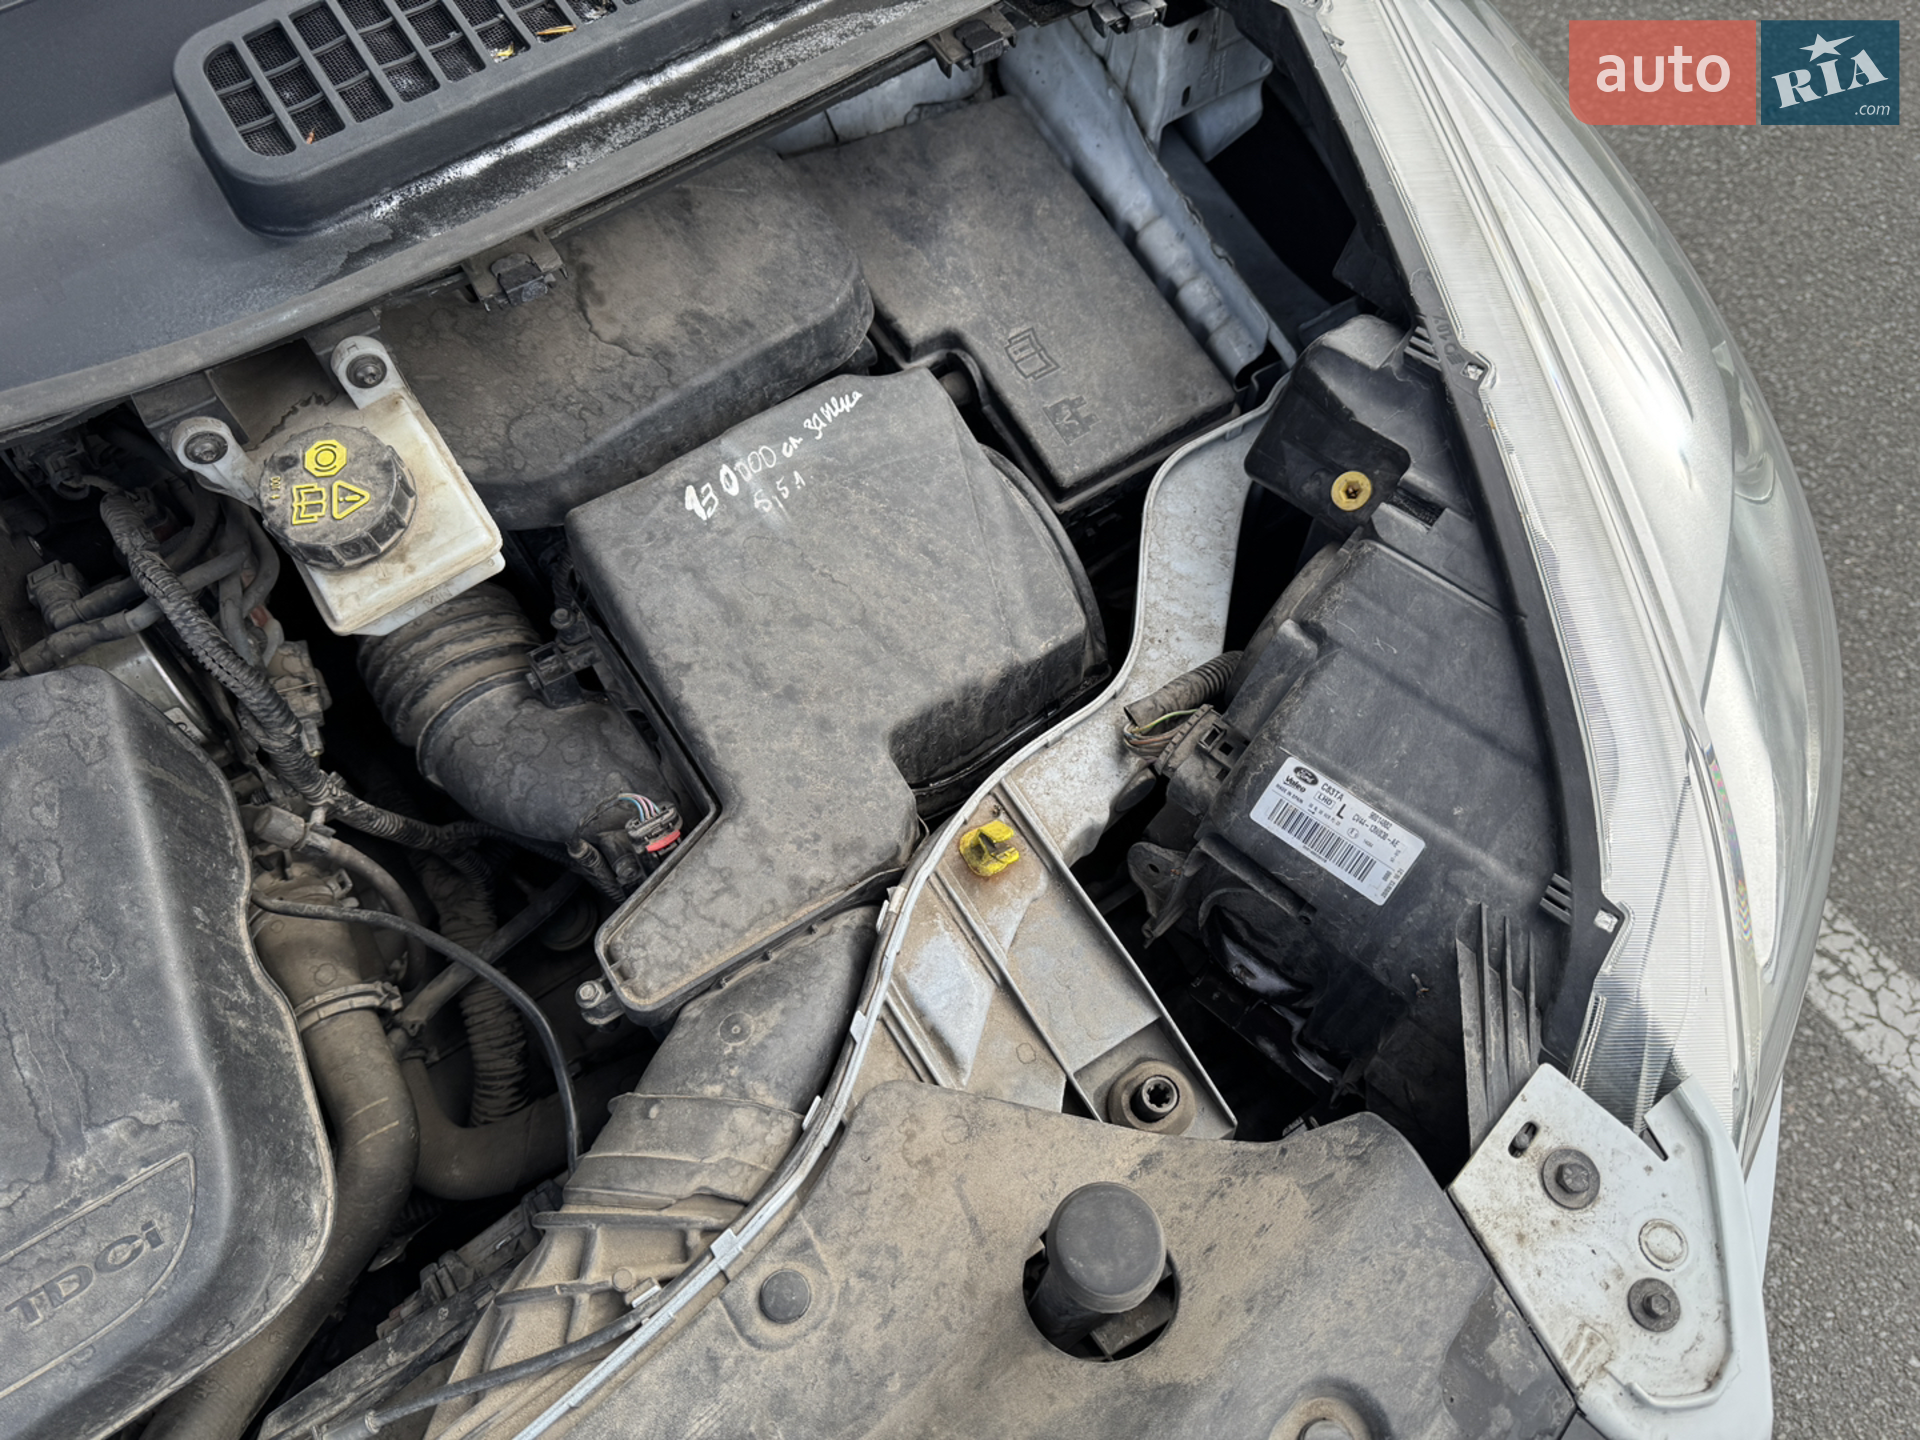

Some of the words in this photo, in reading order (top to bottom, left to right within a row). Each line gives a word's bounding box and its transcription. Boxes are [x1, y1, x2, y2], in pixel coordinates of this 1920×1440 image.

[1285, 775, 1306, 793] Valeo
[1294, 768, 1317, 784] Ford
[1317, 794, 1333, 806] LHD
[1336, 804, 1346, 819] L
[4, 1219, 165, 1323] TDCi
